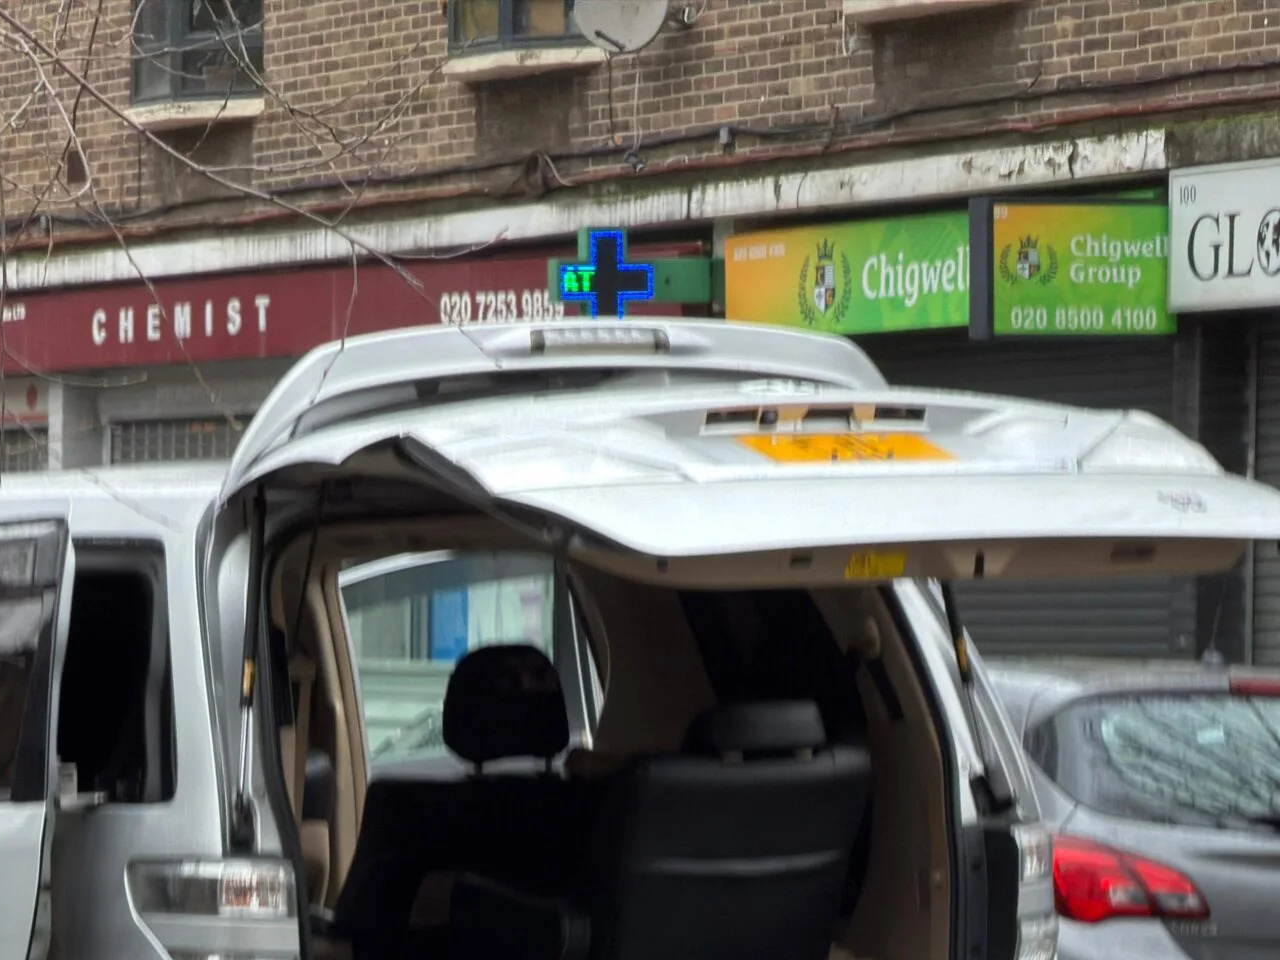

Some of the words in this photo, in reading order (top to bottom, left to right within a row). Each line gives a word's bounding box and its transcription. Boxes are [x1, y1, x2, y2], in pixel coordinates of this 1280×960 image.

[1180, 185, 1196, 205] 100
[1070, 261, 1142, 289] Group
[91, 294, 270, 346] CHEMIST
[440, 290, 471, 326] 020
[475, 288, 517, 323] 7253
[1011, 305, 1047, 330] 020
[1055, 305, 1104, 330] 8500
[1111, 305, 1157, 330] 4100
